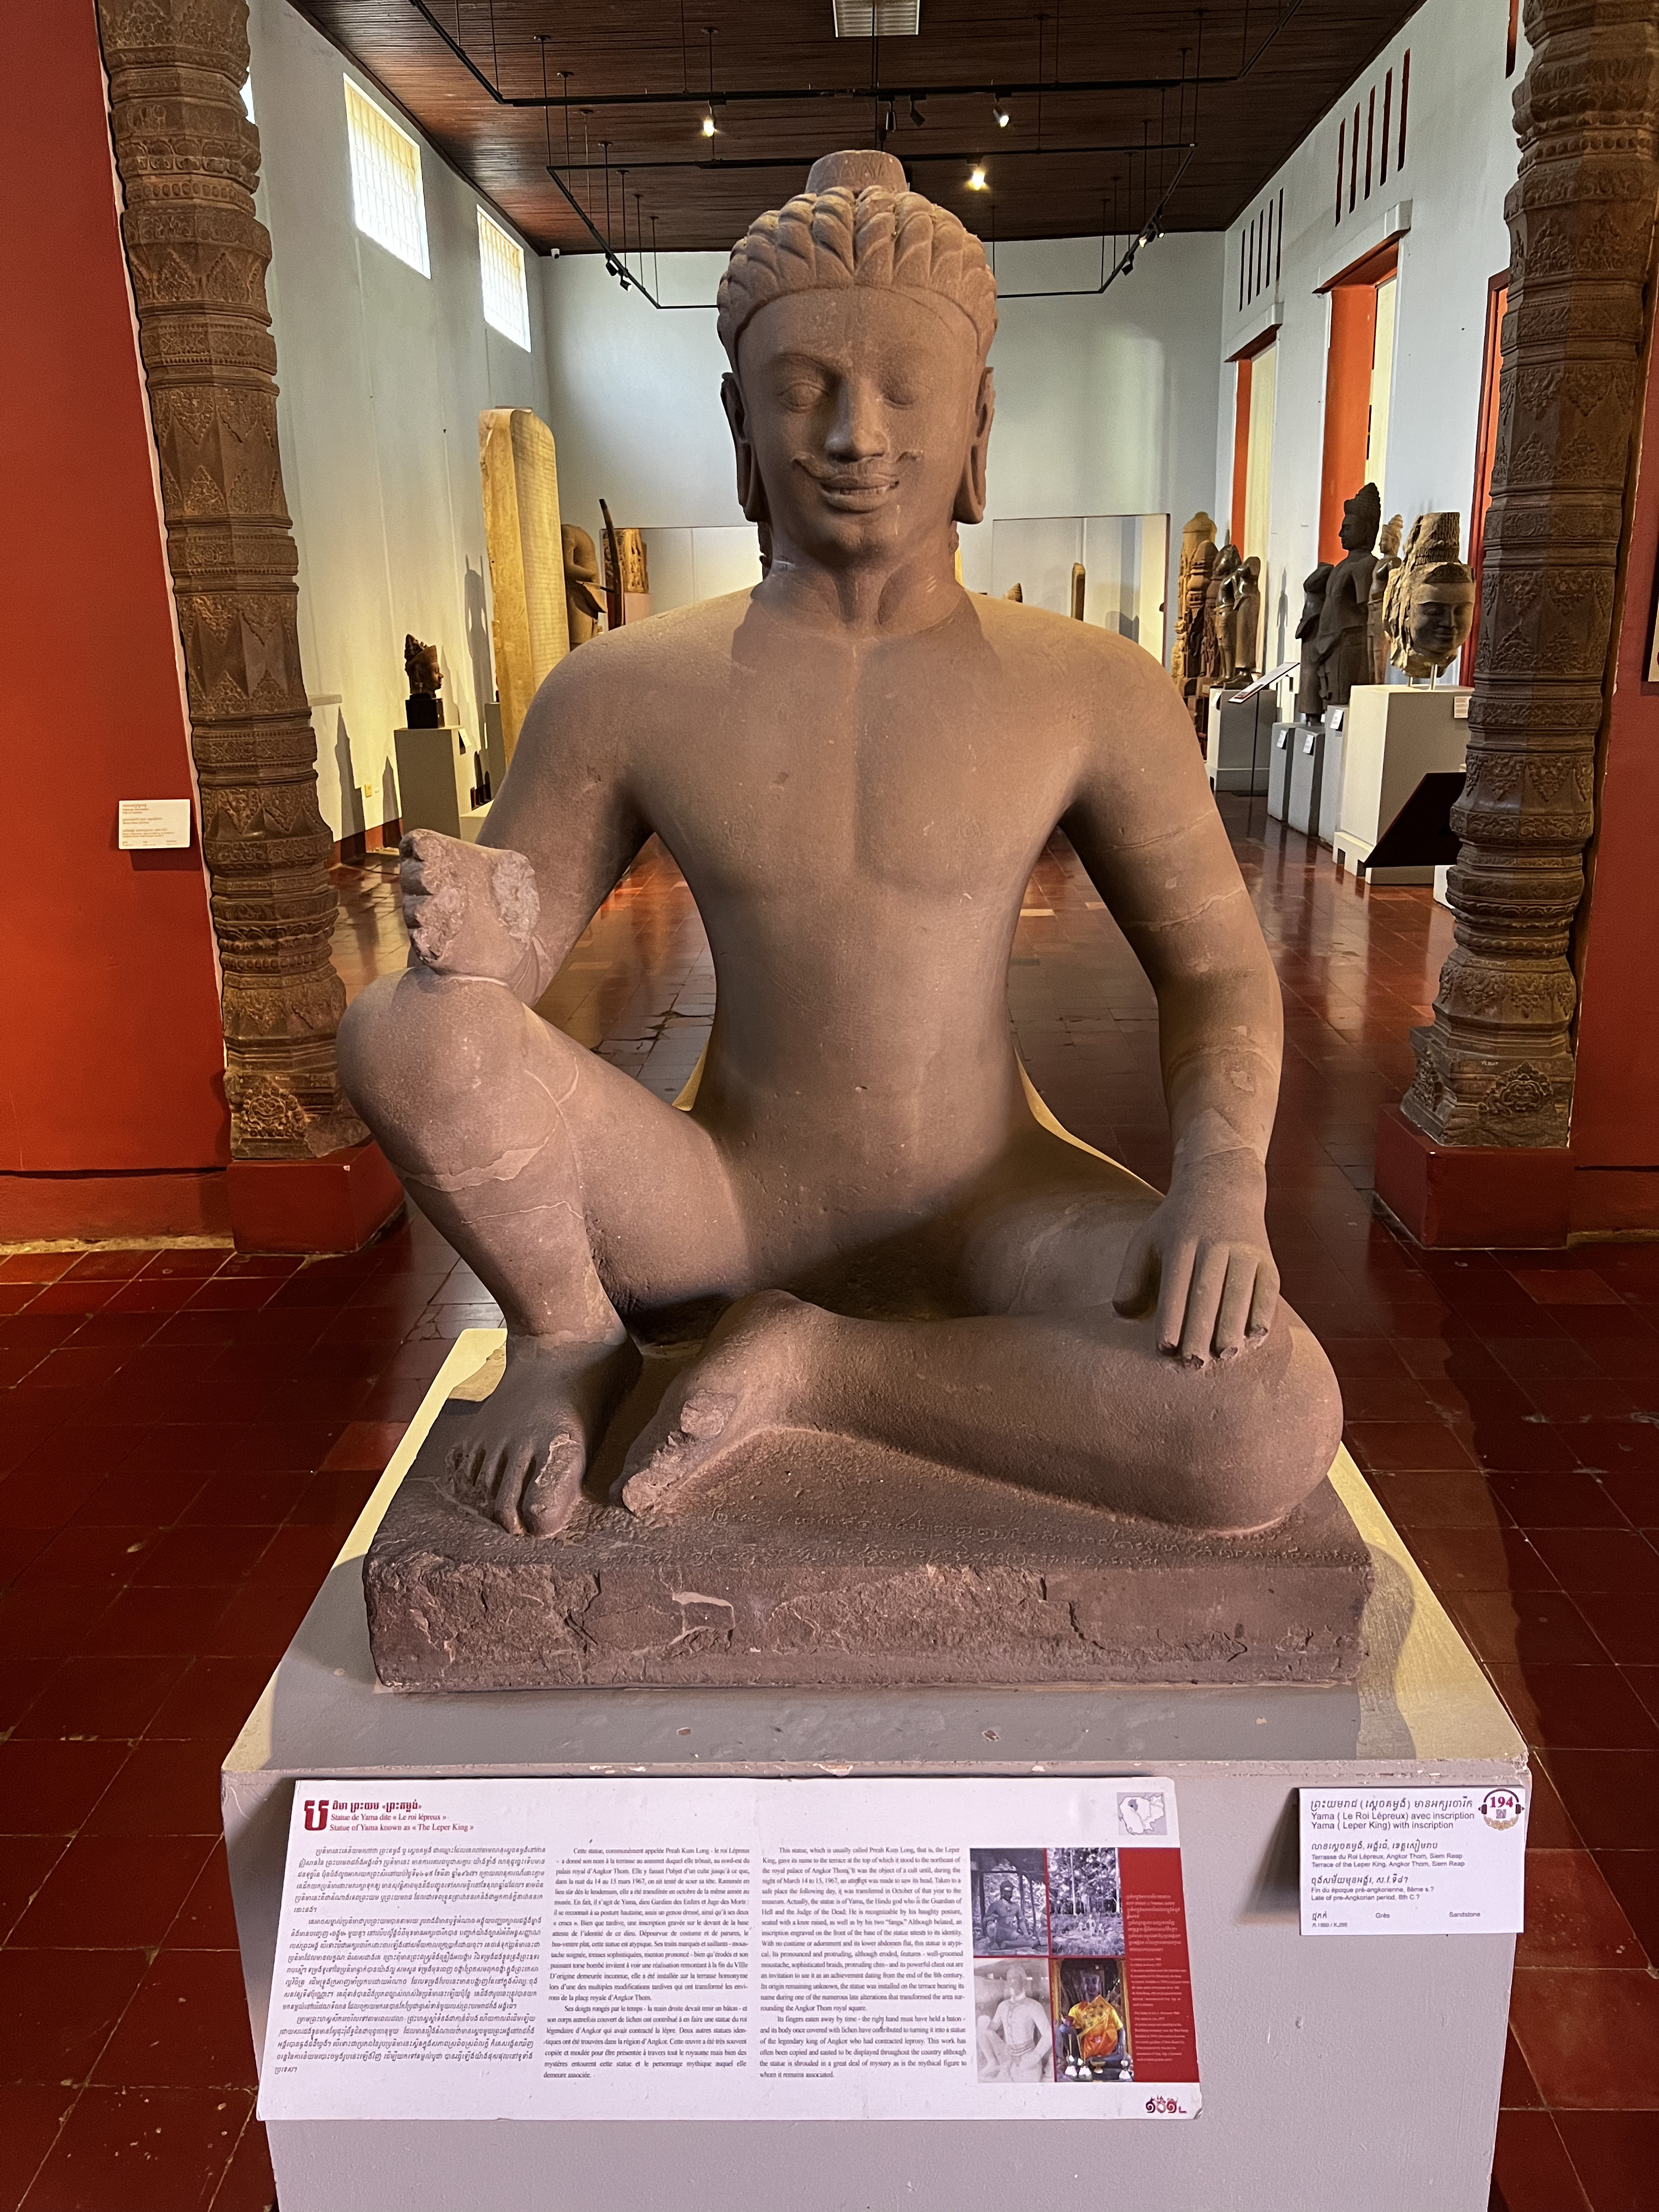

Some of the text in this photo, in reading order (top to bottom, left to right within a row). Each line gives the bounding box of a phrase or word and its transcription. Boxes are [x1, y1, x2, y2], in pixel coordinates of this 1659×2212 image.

[1490, 1796, 1514, 1808] 194
[418, 1813, 441, 1822] lépreux
[1372, 1812, 1409, 1821] Lépreux)
[1433, 1812, 1475, 1821] inscription
[432, 1824, 451, 1833] Leper
[453, 1824, 468, 1832] King
[1343, 1822, 1366, 1830] Leper
[1369, 1822, 1390, 1830] King)
[1412, 1822, 1454, 1830] inscription
[1372, 1861, 1387, 1870] King,
